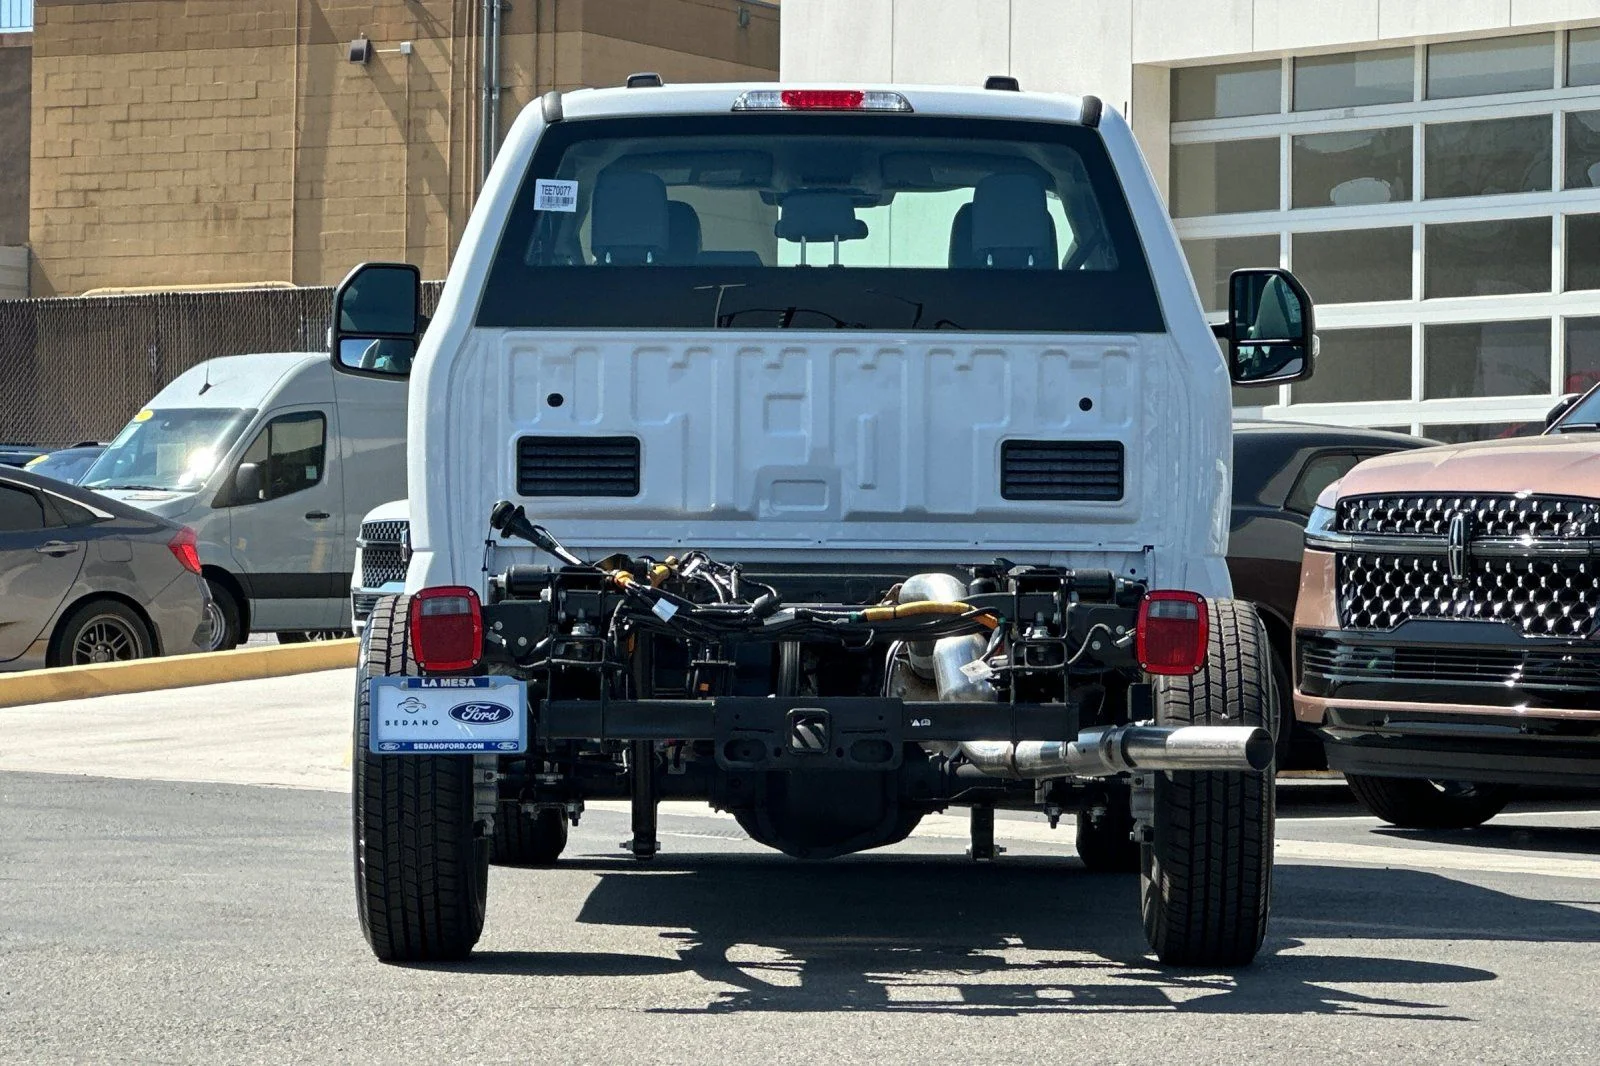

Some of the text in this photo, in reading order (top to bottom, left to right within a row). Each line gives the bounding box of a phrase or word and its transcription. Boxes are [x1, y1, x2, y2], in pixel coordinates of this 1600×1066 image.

[541, 184, 571, 196] TEE70077
[421, 678, 476, 688] LA MESA
[461, 704, 500, 721] Ford
[413, 742, 485, 750] SEDANOFORD.COM
